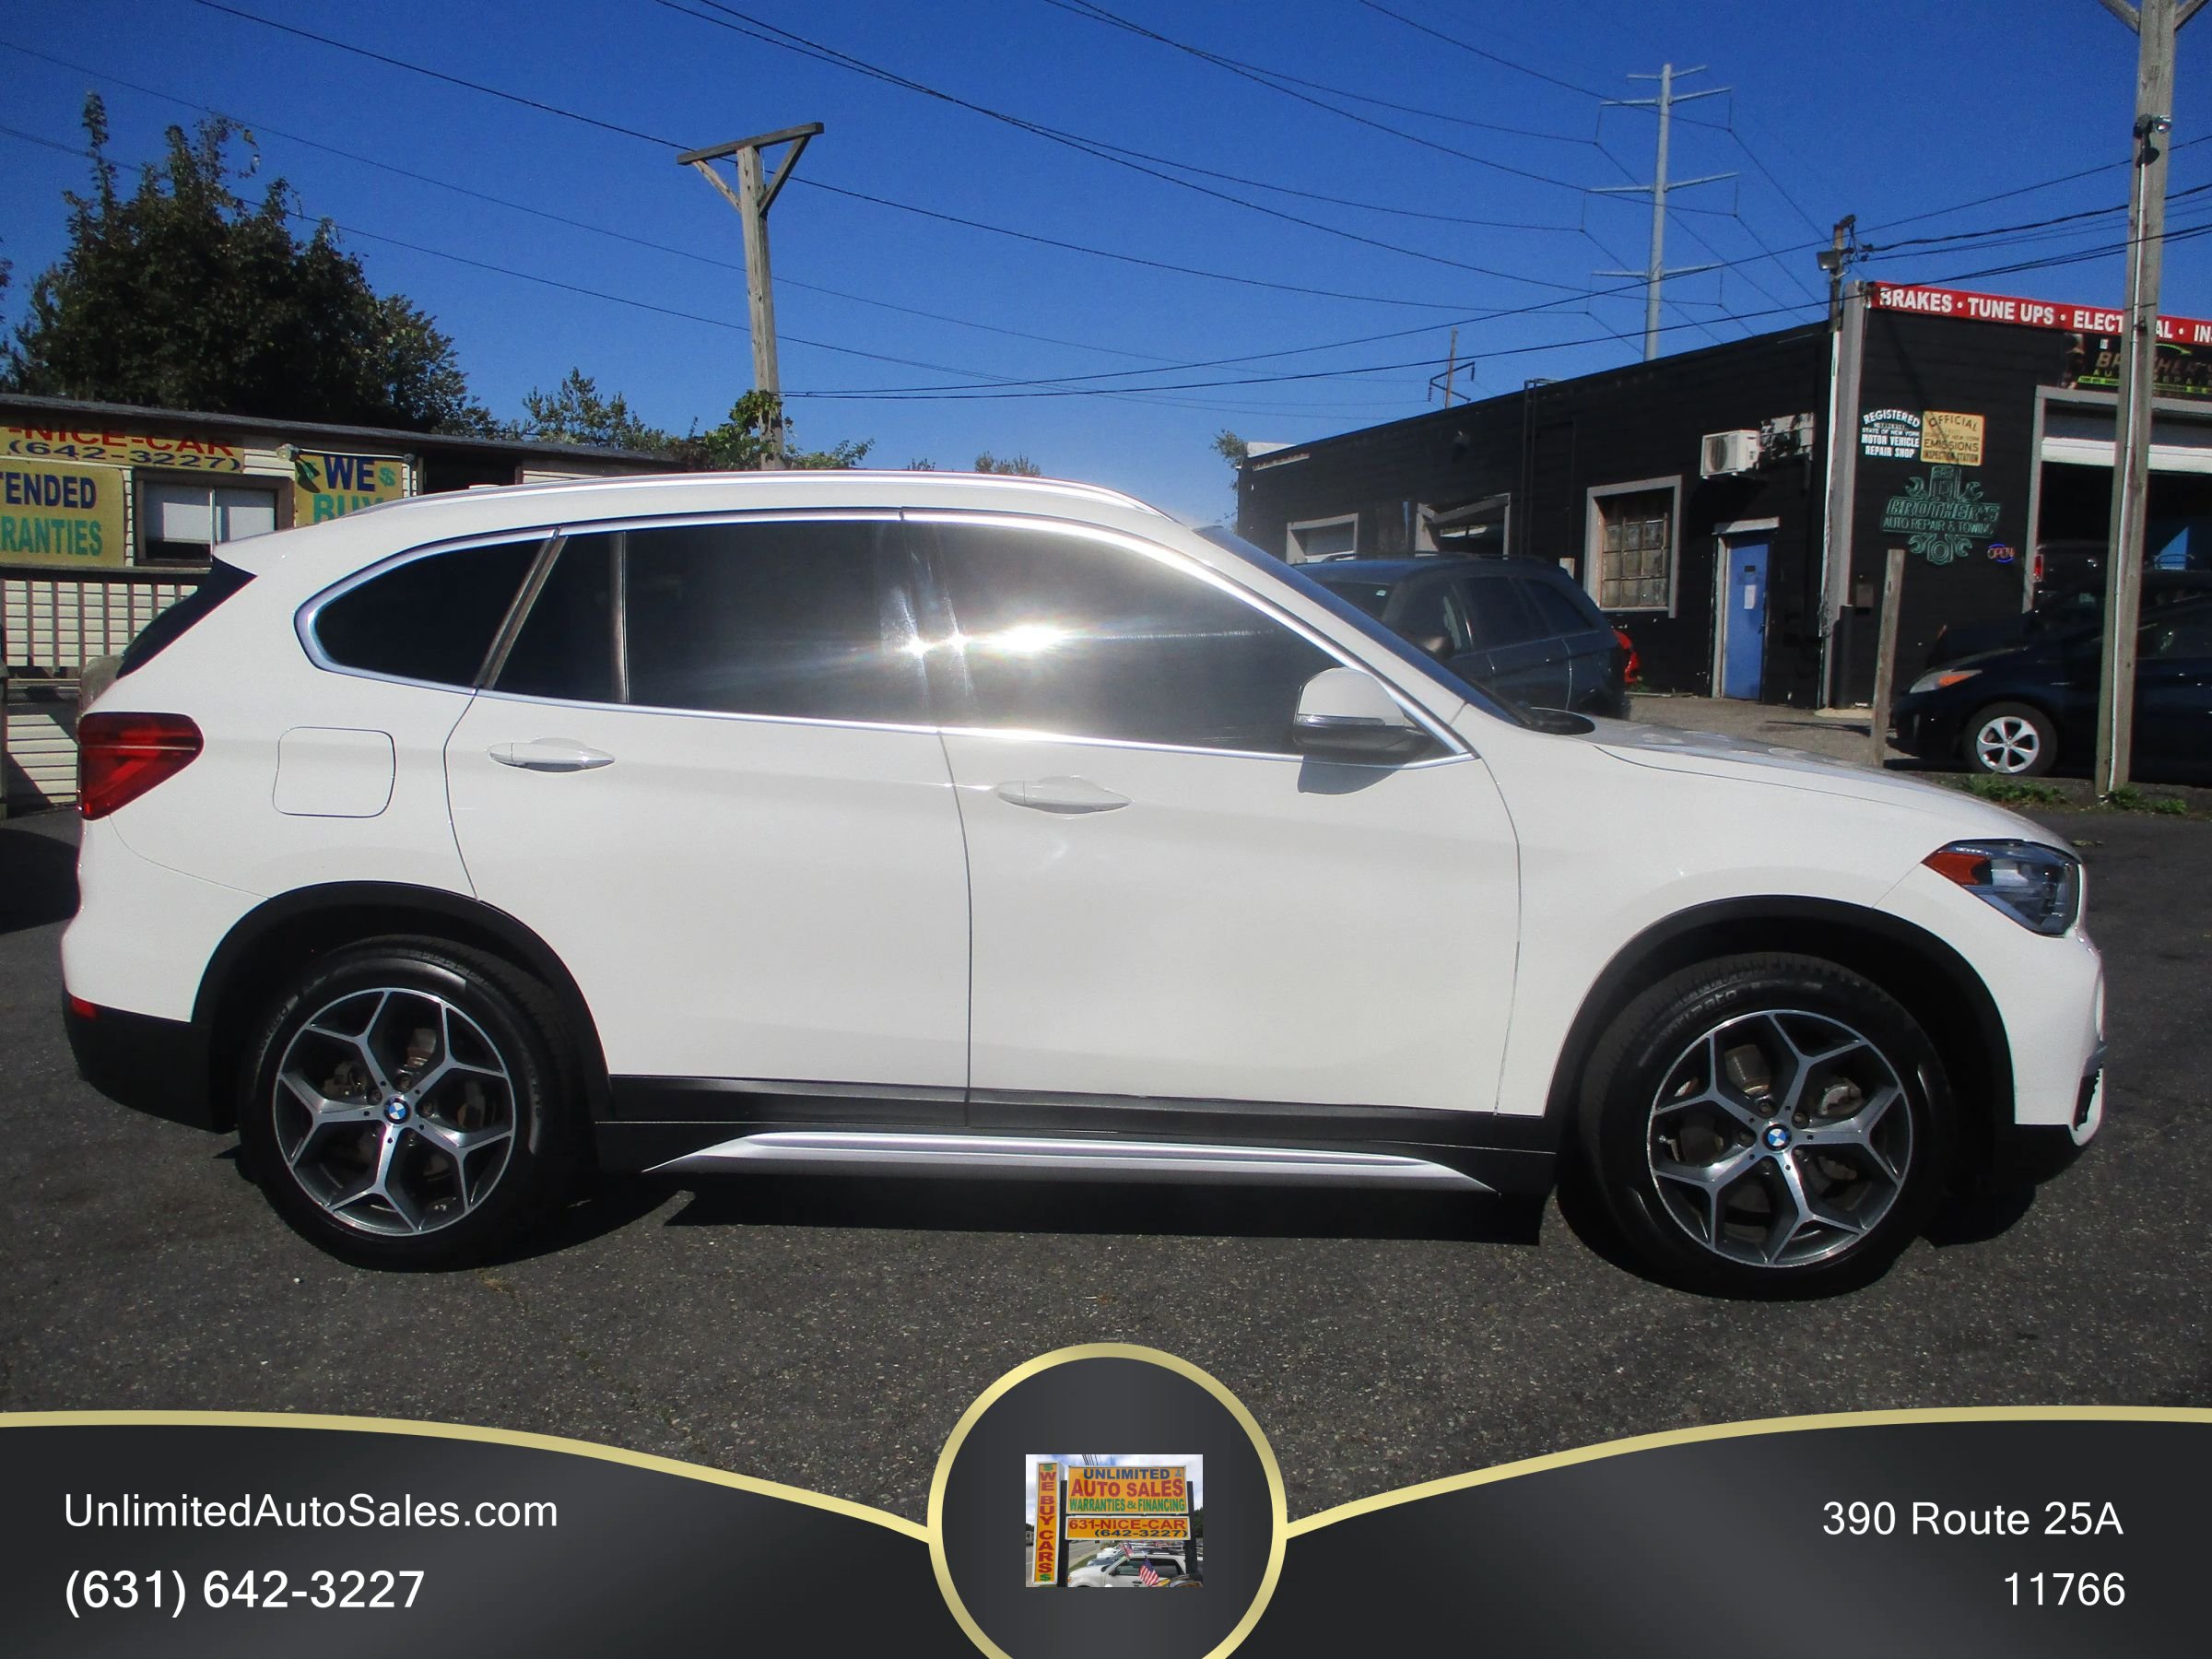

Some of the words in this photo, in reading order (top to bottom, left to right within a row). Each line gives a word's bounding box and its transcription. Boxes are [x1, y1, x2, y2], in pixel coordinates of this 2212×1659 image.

[1880, 287, 1953, 313] BRAKES
[1968, 297, 2016, 321] TUNE
[2020, 303, 2054, 325] UPS
[2194, 324, 2212, 344] IN
[1863, 408, 1921, 428] REGISTERED
[1928, 415, 1978, 431] OFFICIAL
[1861, 434, 1888, 445] MOTOR
[1889, 436, 1920, 448] VEHICLE
[1924, 438, 1979, 453] EMISSIONS
[8, 440, 241, 472] (642-3227)
[1865, 445, 1892, 457] REPAIR
[1894, 447, 1915, 458] SHOP
[324, 454, 376, 492] WE
[0, 472, 97, 510] ENDED
[1883, 516, 1909, 529] AUTO
[1911, 518, 1945, 532] REPAIR
[1987, 546, 2017, 559] OPEN
